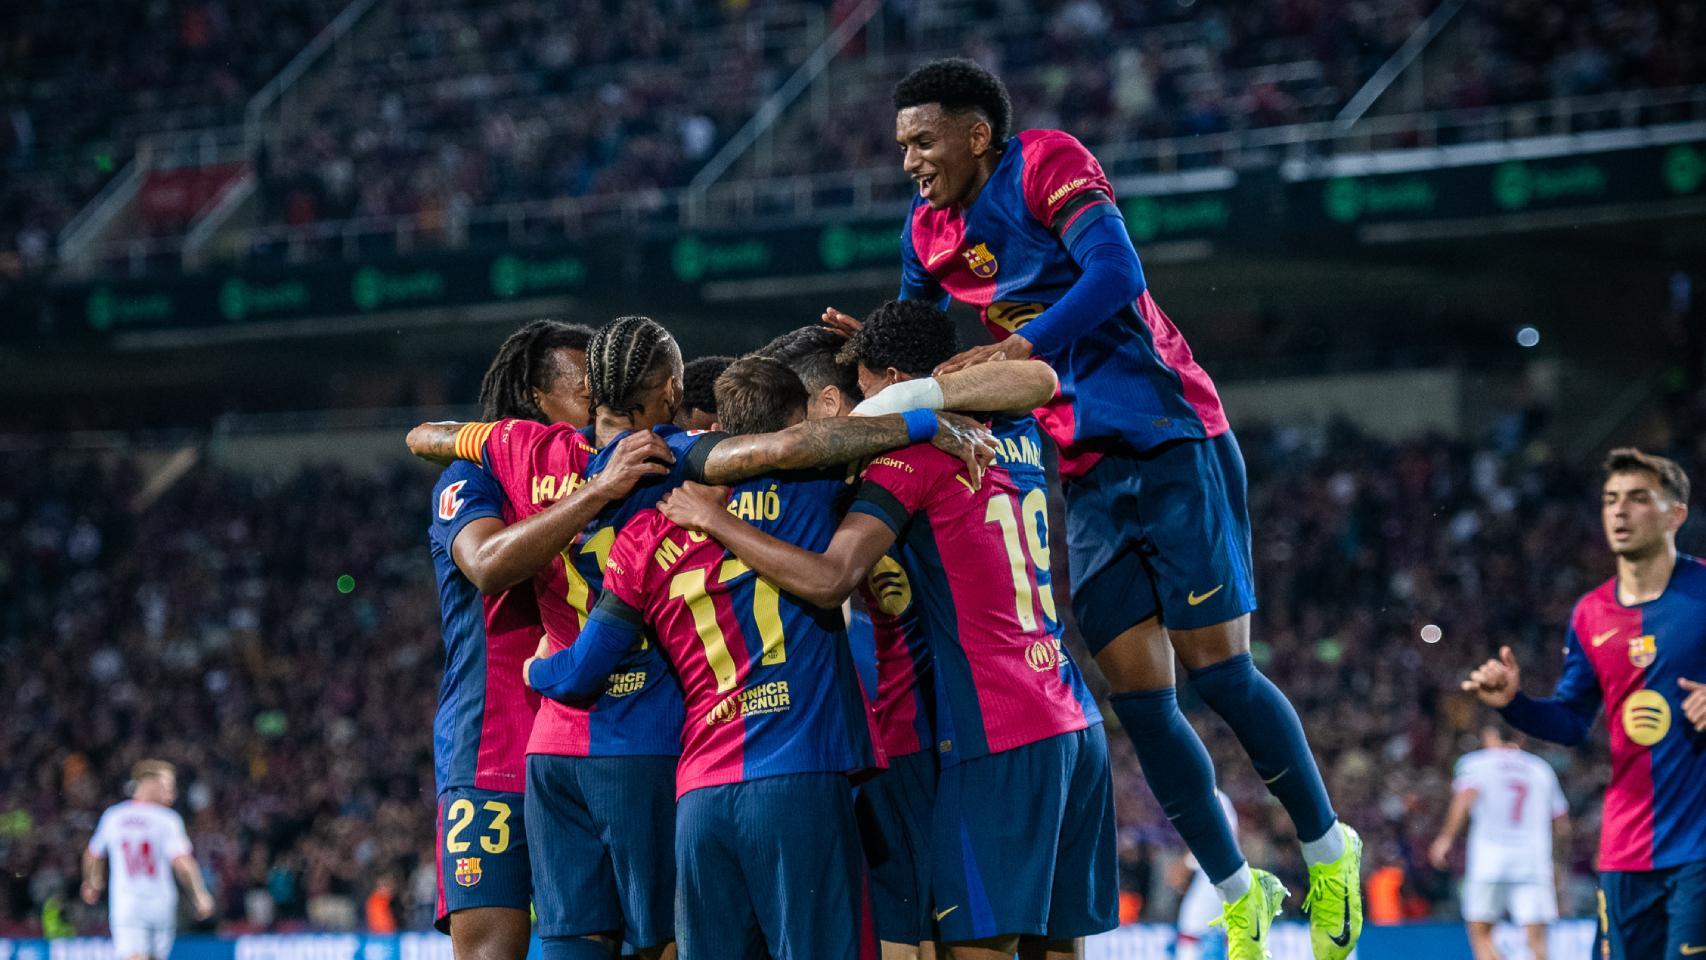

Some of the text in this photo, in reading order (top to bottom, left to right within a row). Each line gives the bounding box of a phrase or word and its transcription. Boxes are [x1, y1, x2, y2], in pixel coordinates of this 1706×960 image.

[985, 488, 1057, 632] 19
[669, 558, 786, 695] 17
[737, 681, 789, 702] UNHCR
[740, 693, 791, 714] ACNUR
[1508, 782, 1528, 824] 7
[446, 799, 511, 854] 23
[122, 841, 156, 877] 14
